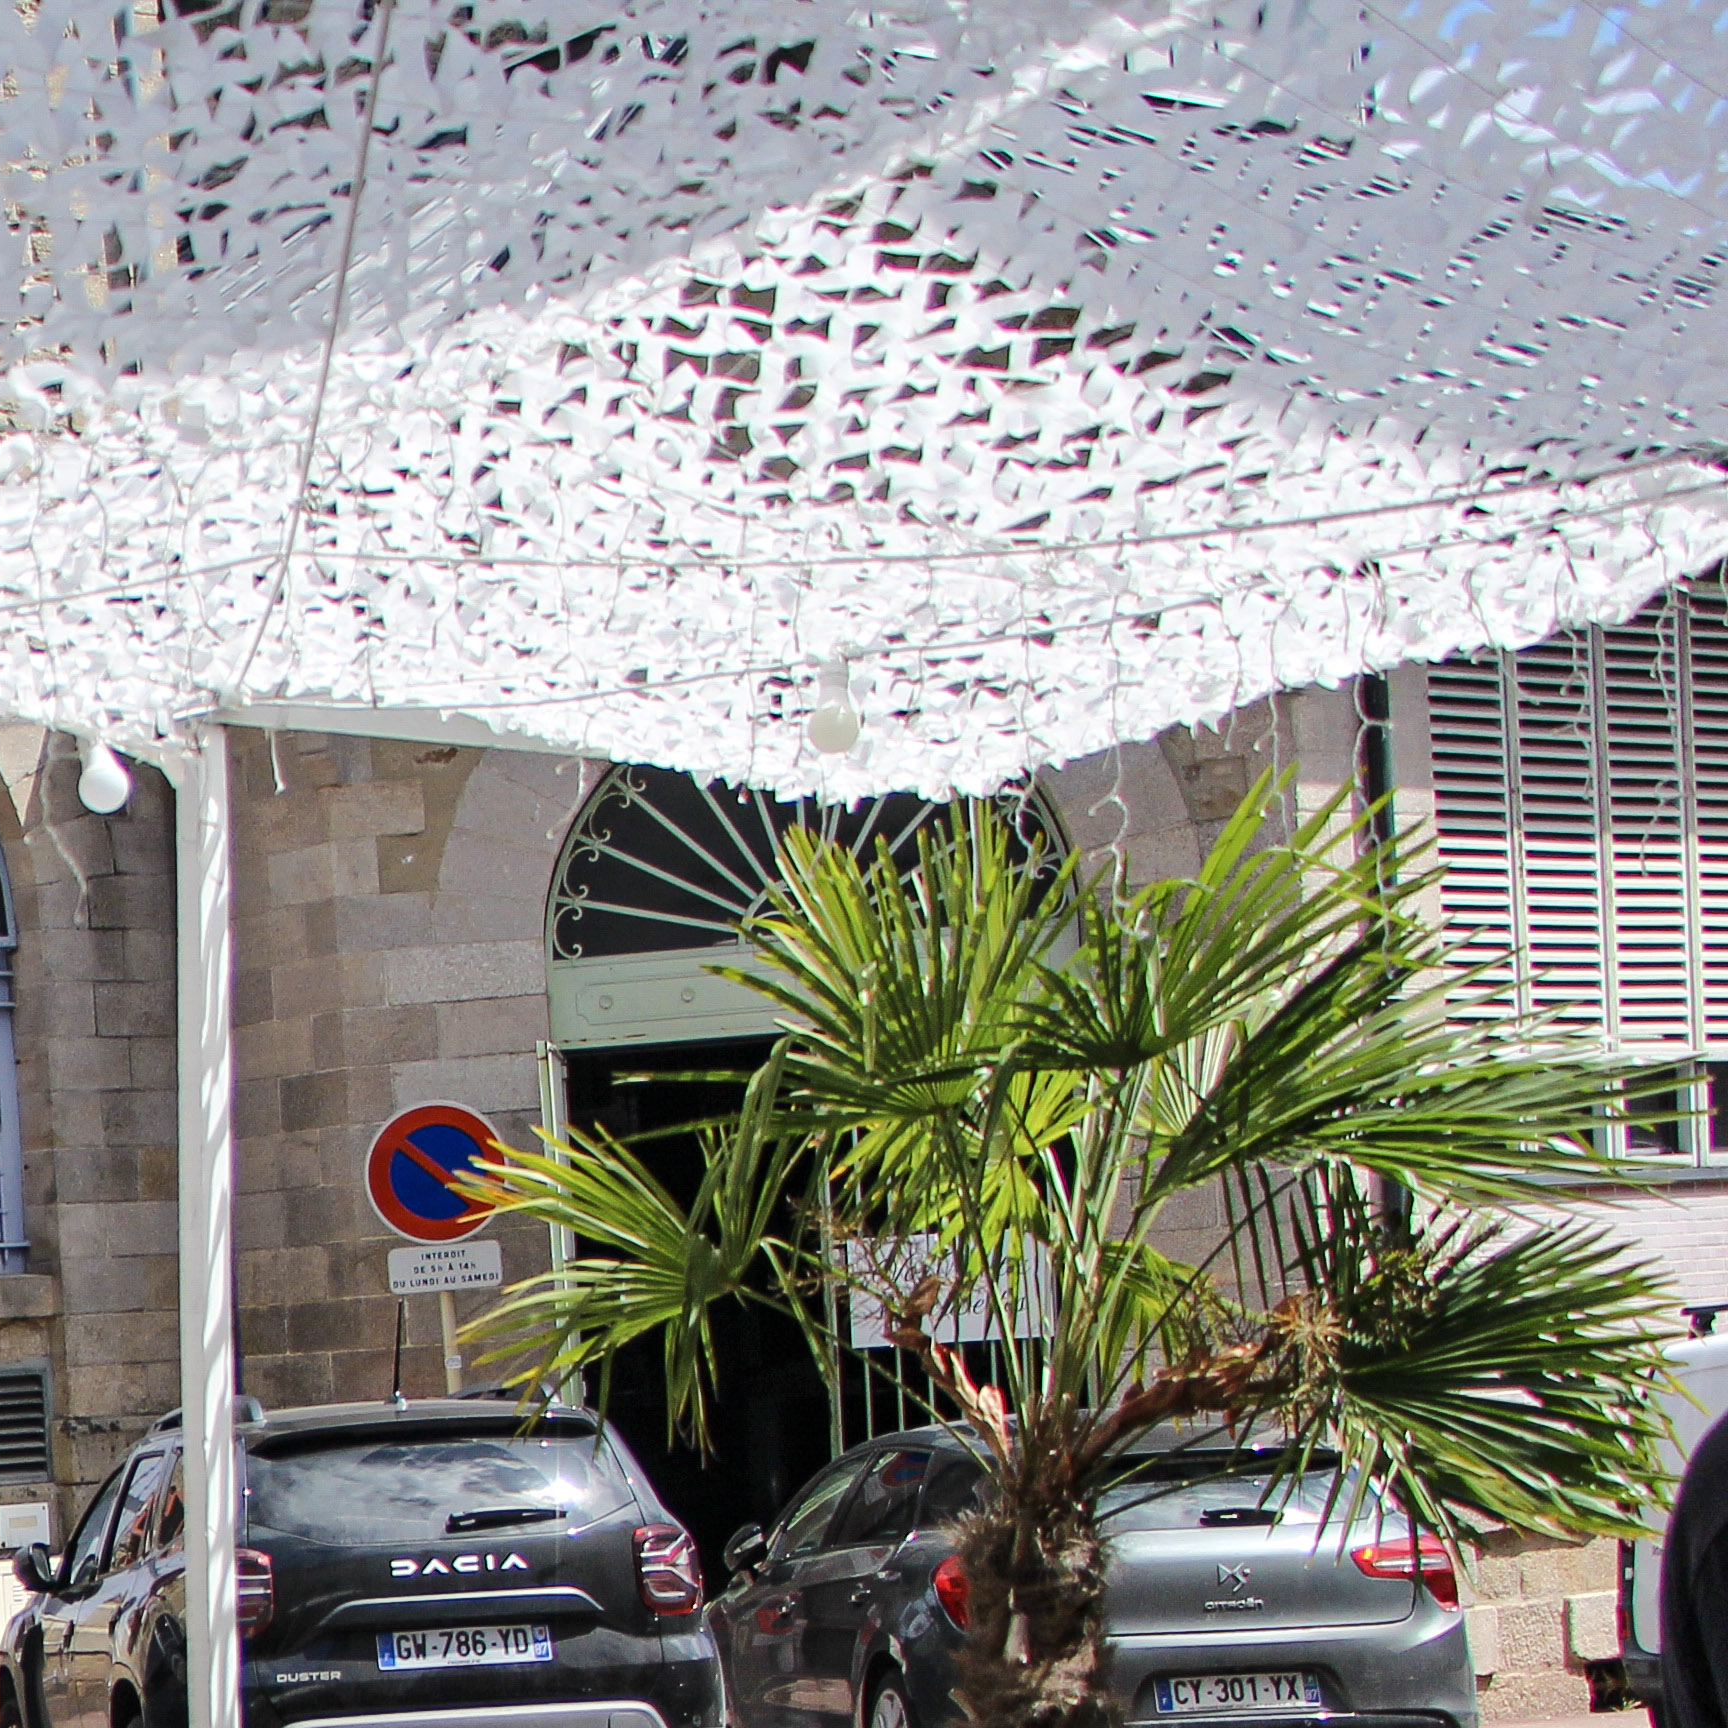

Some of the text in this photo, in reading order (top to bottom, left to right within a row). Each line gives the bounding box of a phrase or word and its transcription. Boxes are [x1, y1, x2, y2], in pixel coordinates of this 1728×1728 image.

[420, 1249, 466, 1261] INTERDIT
[413, 1265, 426, 1275] DE
[459, 1262, 477, 1271] 14h
[392, 1272, 499, 1289] DU LUNDI AU SAMEDI
[390, 1553, 529, 1576] DACIA
[395, 1627, 529, 1661] GW-786-YD
[534, 1641, 549, 1657] 87
[276, 1670, 342, 1683] DUSTER
[1173, 1675, 1300, 1705] CY-301-YX
